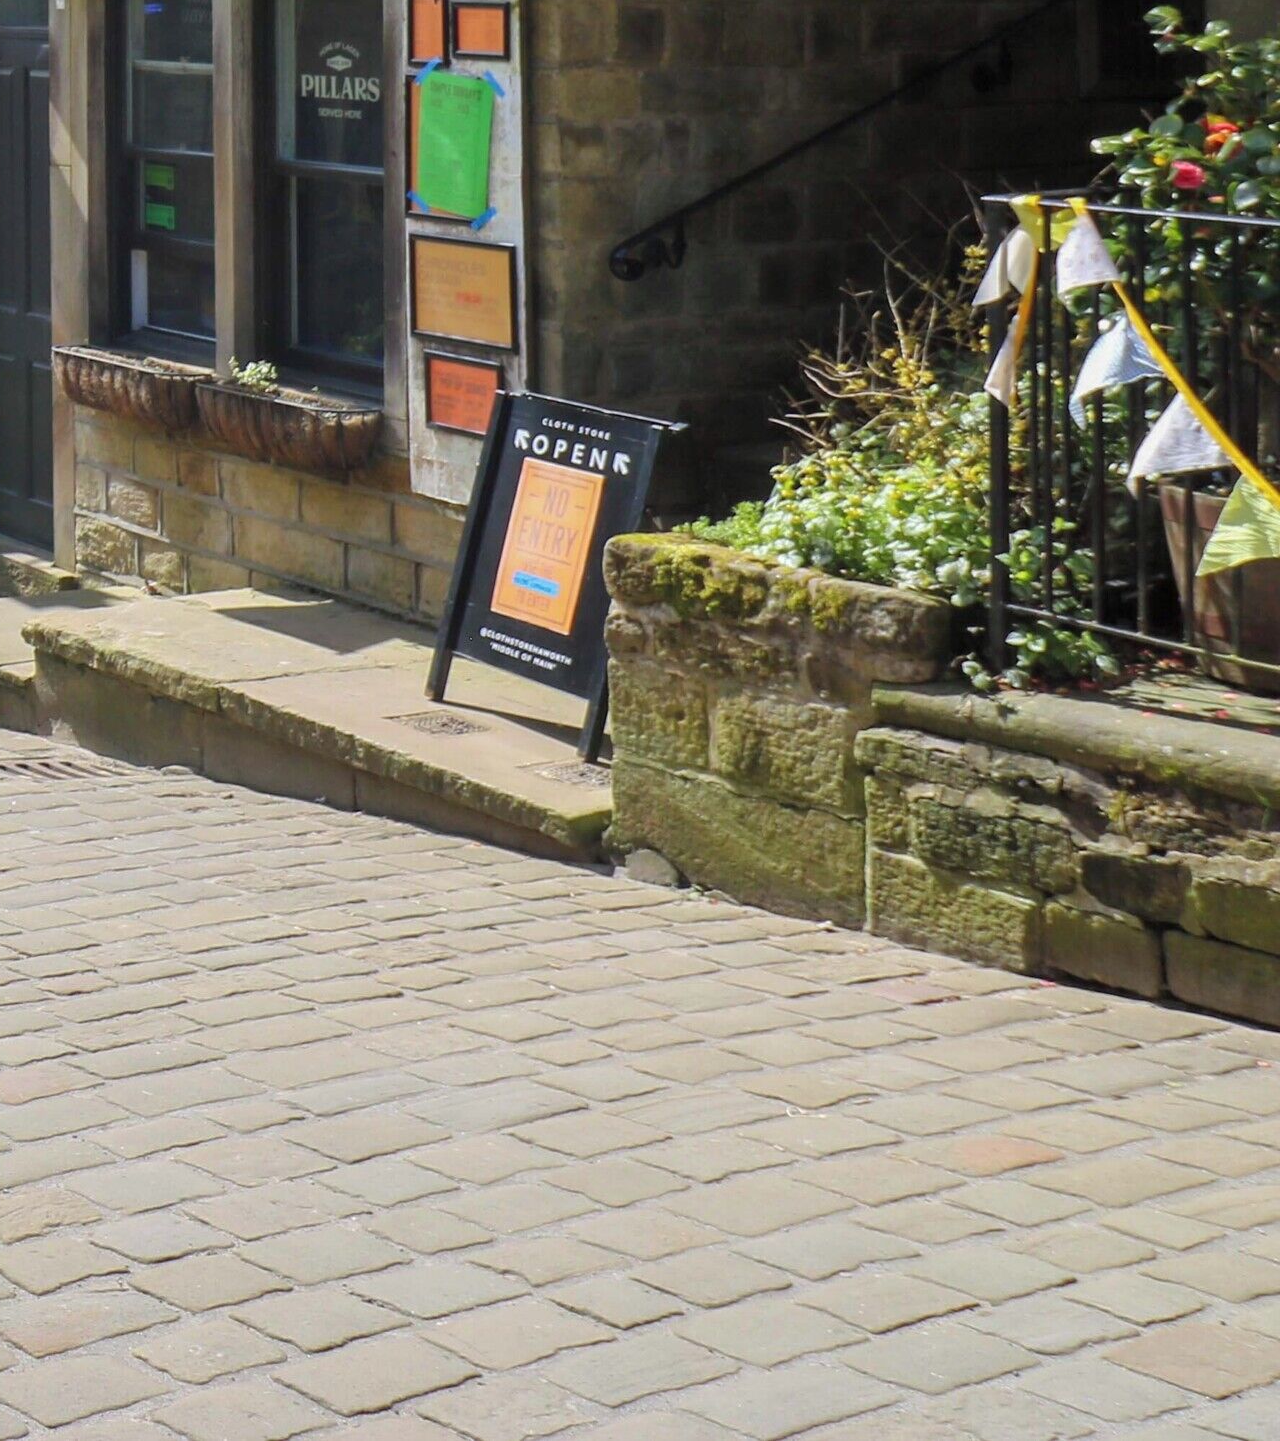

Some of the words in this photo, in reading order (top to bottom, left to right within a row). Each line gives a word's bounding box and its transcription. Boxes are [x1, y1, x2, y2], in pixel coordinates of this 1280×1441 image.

[301, 74, 380, 102] PILLARS
[542, 417, 576, 432] CLOTH
[578, 426, 612, 441] STORE
[532, 434, 608, 470] OPEN
[543, 485, 570, 518] NO
[518, 515, 579, 558] ENTRY
[480, 627, 572, 665] @CLOTHSTOREHAWORTH
[521, 652, 532, 662] OF
